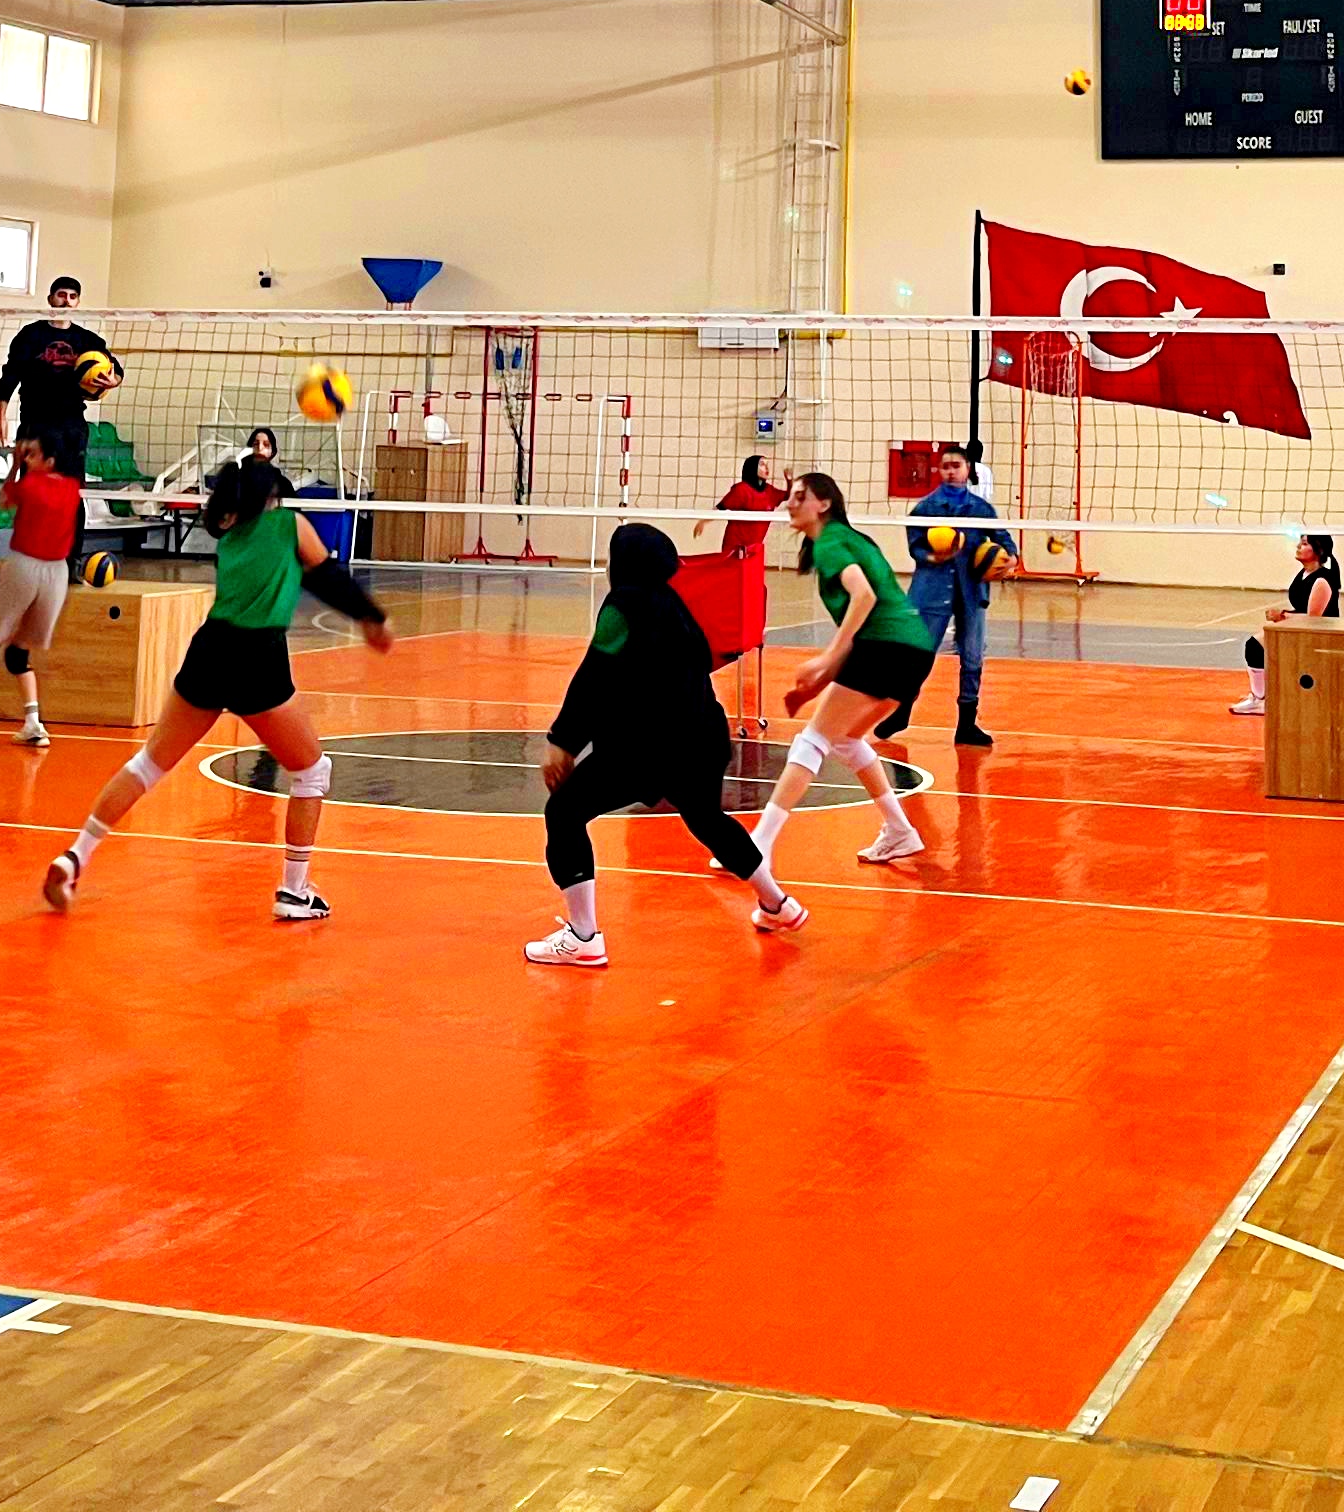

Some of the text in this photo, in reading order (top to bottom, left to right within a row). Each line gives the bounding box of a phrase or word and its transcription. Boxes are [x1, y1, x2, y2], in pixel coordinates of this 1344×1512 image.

[1243, 3, 1261, 12] TIME
[1283, 19, 1320, 33] FAUL/SET
[1185, 112, 1212, 126] HOME
[1295, 110, 1323, 124] GUEST
[1237, 136, 1272, 149] SCORE
